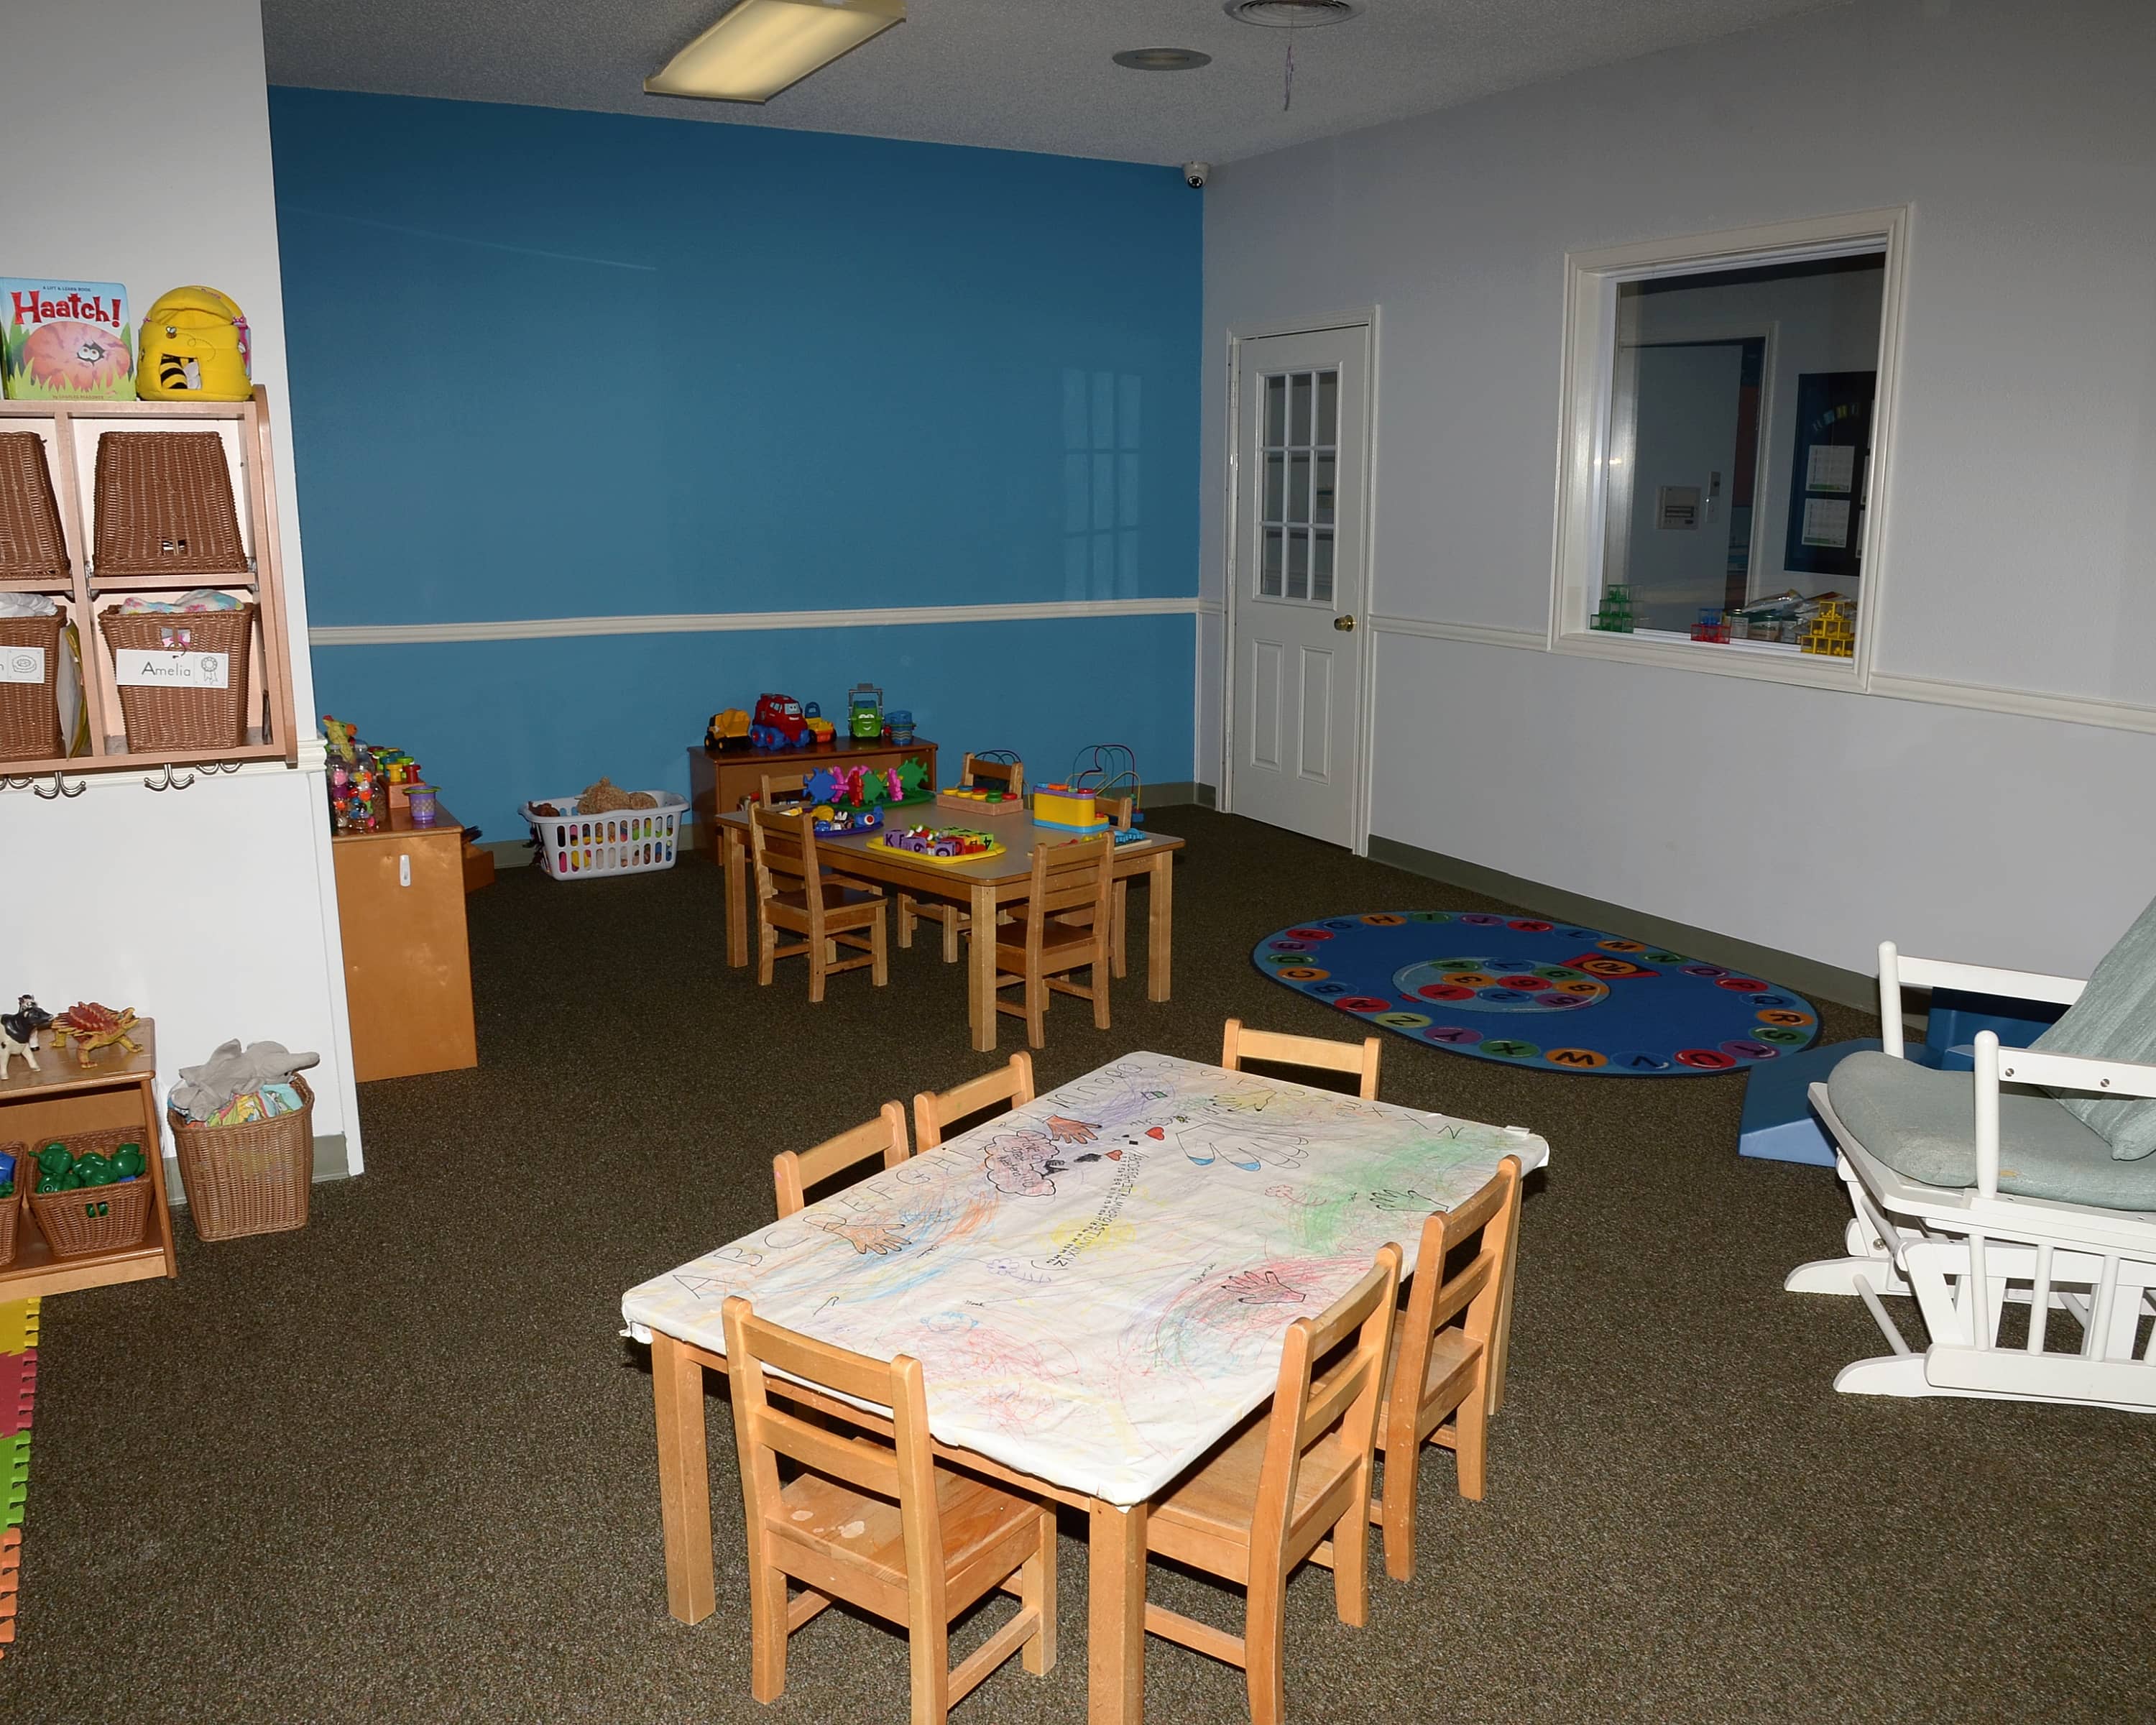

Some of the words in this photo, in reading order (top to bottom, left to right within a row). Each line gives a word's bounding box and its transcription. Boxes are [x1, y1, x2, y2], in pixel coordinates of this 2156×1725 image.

[10, 290, 121, 328] Haatch!
[141, 661, 191, 677] Amelia
[885, 833, 893, 847] K
[1276, 942, 1306, 950] E
[1610, 942, 1639, 950] M
[1648, 954, 1674, 963] N
[1592, 961, 1628, 973] 10
[1287, 970, 1316, 979] C
[1454, 975, 1483, 984] 3
[1314, 985, 1345, 994] B
[1725, 981, 1756, 990] P
[1491, 990, 1523, 1000] 2
[1753, 995, 1784, 1006] Q
[1386, 1015, 1422, 1026] Z
[1769, 1013, 1802, 1025] R
[1434, 1031, 1464, 1042] Y
[1764, 1029, 1797, 1041] S
[1493, 1042, 1526, 1056] X
[1554, 1050, 1596, 1067] W
[672, 1275, 737, 1300] A
[713, 1247, 763, 1266] B
[764, 1231, 811, 1248] C
[839, 1196, 875, 1213] E
[867, 1181, 893, 1200] F
